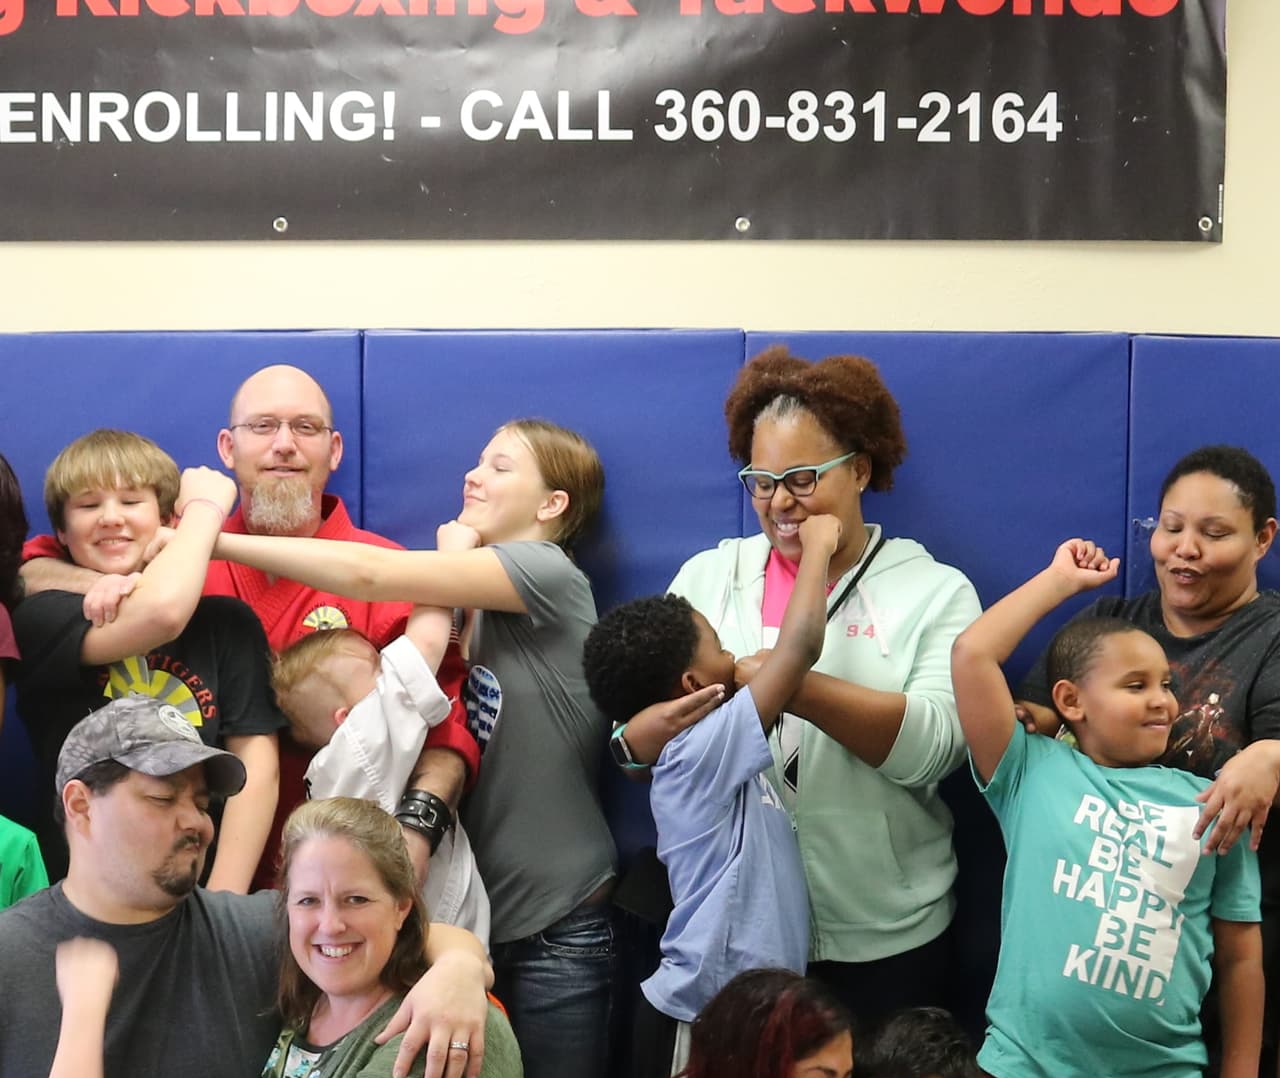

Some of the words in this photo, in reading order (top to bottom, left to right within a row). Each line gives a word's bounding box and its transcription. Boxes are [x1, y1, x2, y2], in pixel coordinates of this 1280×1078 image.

[0, 90, 396, 143] ENROLLING!
[420, 115, 442, 129] -
[460, 90, 633, 141] CALL
[654, 89, 1063, 143] 360-831-2164
[147, 655, 216, 718] TIGERS
[1073, 794, 1174, 869] REAL
[1087, 836, 1142, 881] BE
[1052, 858, 1185, 931] HAPPY
[1094, 912, 1157, 962] BE
[1062, 944, 1172, 1006] KIND
